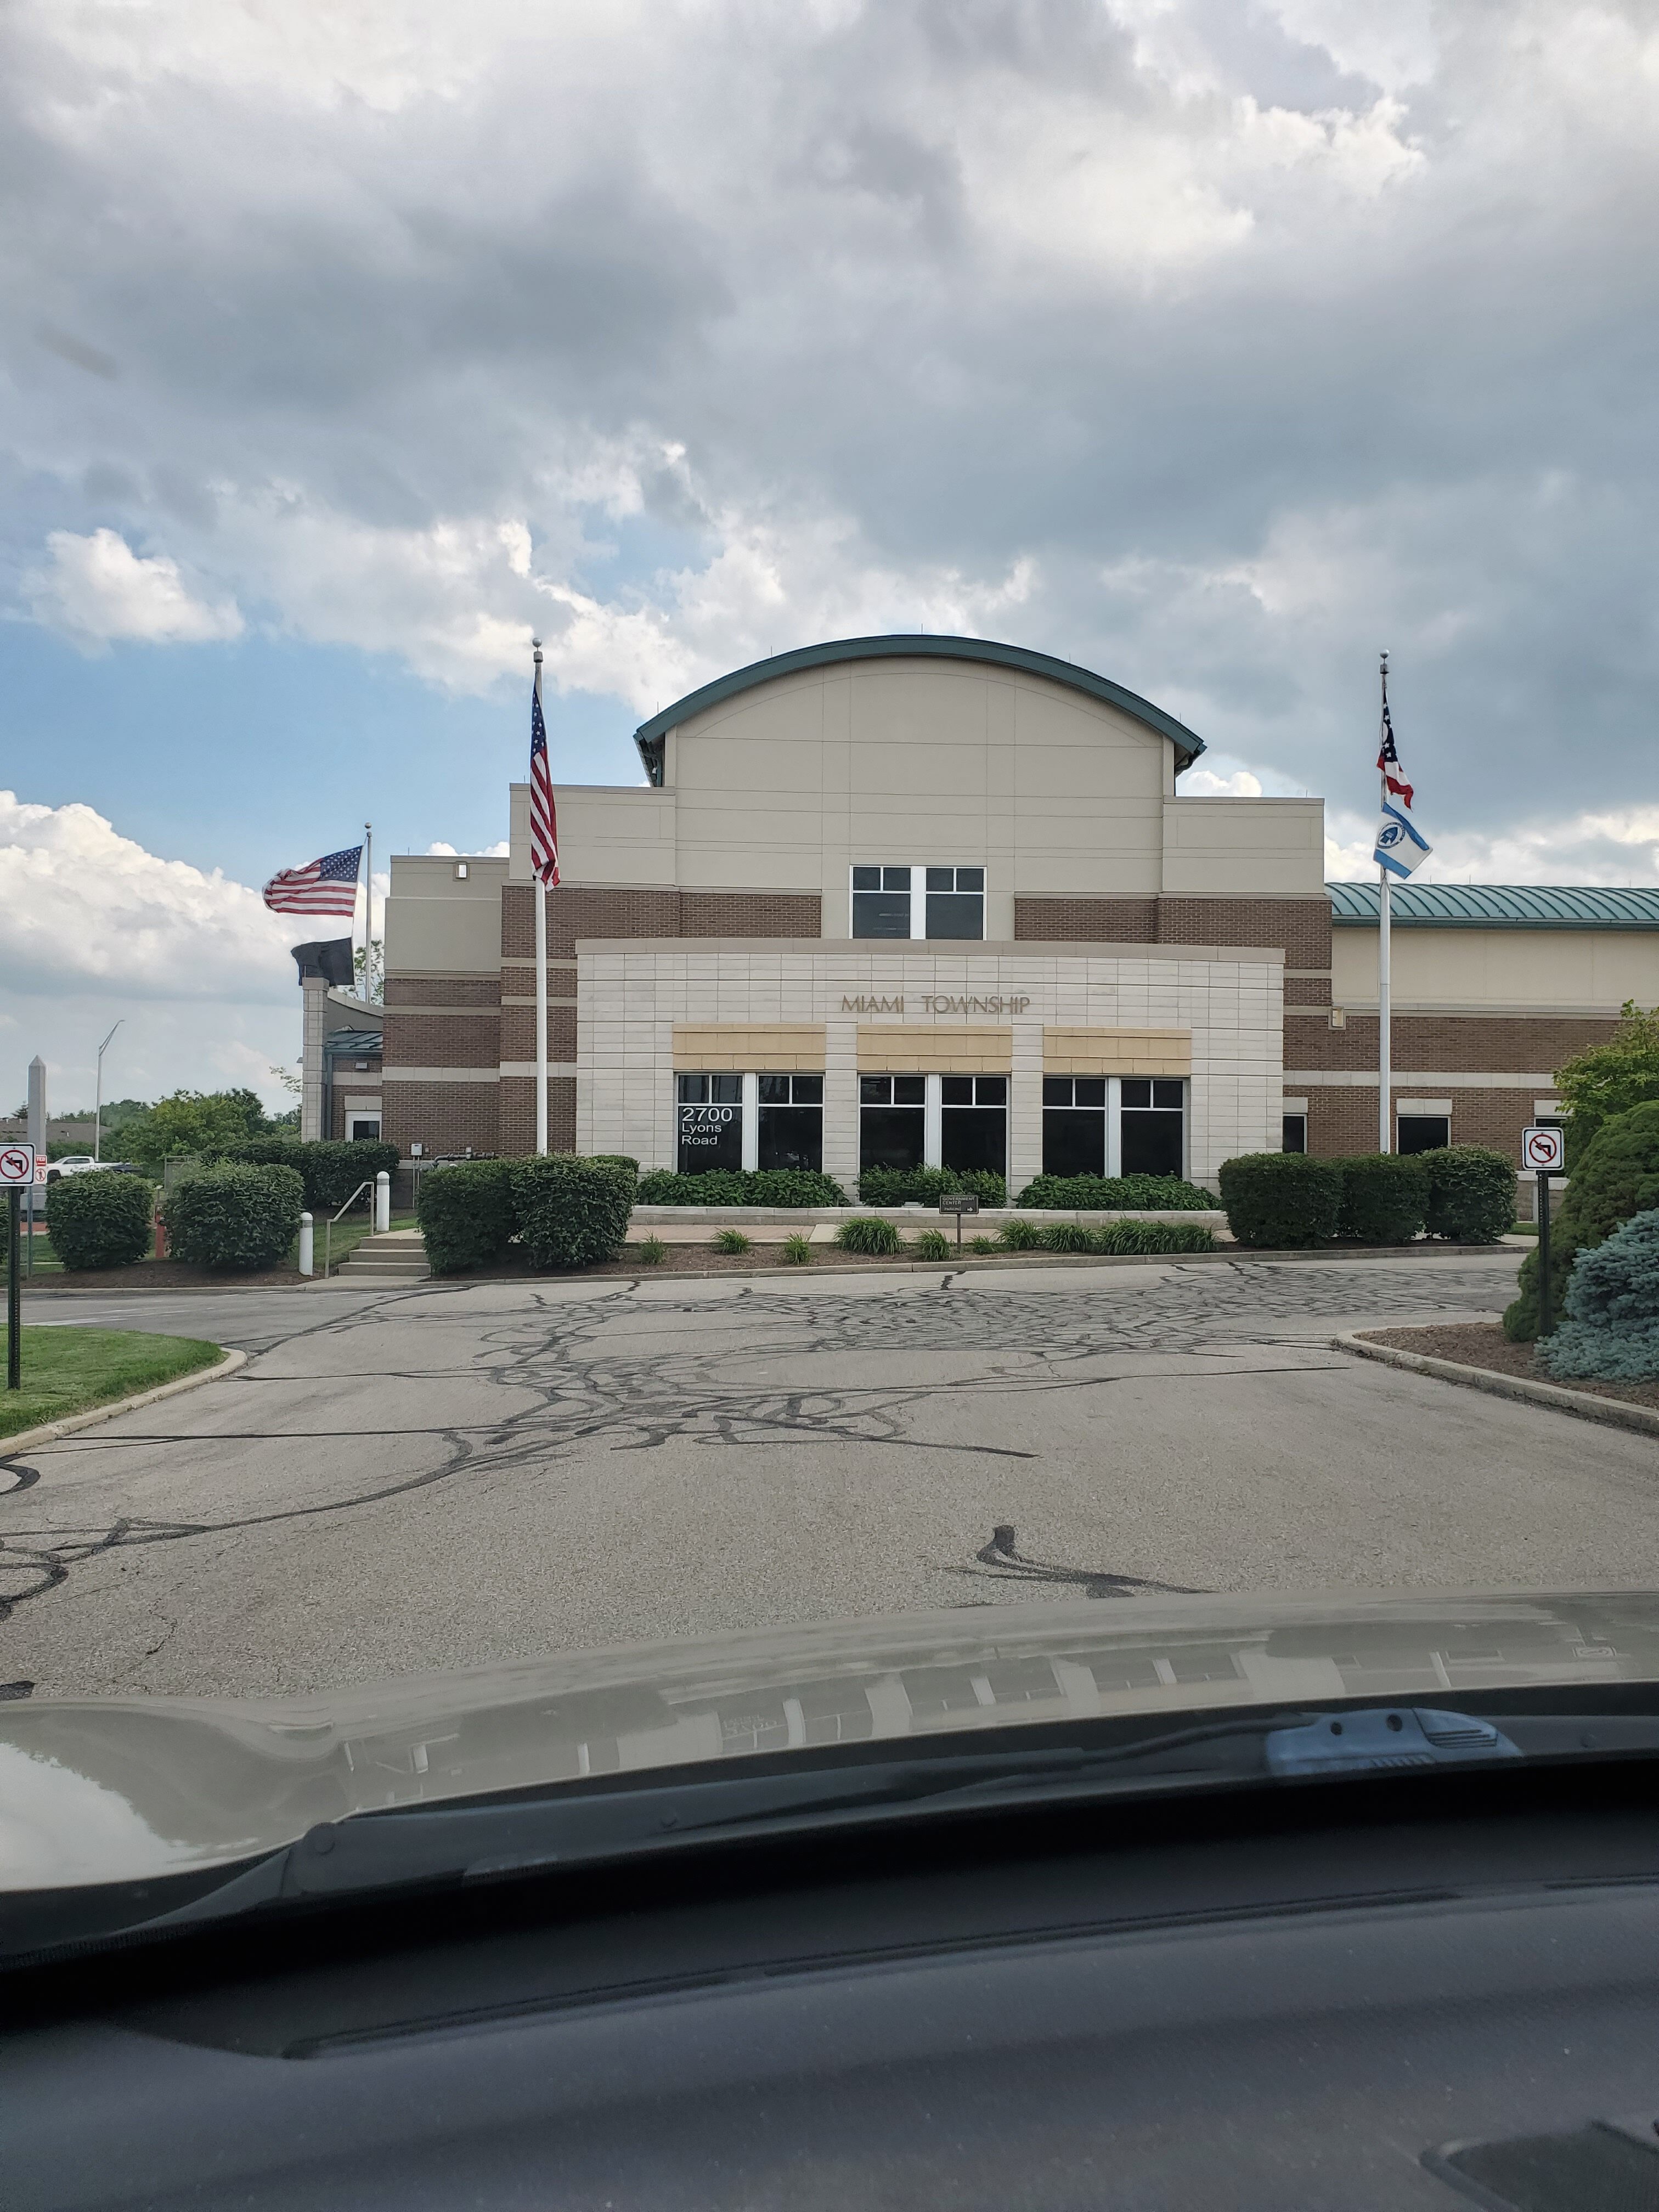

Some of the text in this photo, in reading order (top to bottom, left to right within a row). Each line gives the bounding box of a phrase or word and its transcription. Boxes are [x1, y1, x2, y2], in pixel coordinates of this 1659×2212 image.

[842, 994, 1030, 1014] MIAMI TOWNSHIP
[682, 1107, 733, 1122] 2700
[682, 1122, 723, 1135] Lyons
[681, 1135, 718, 1146] Road
